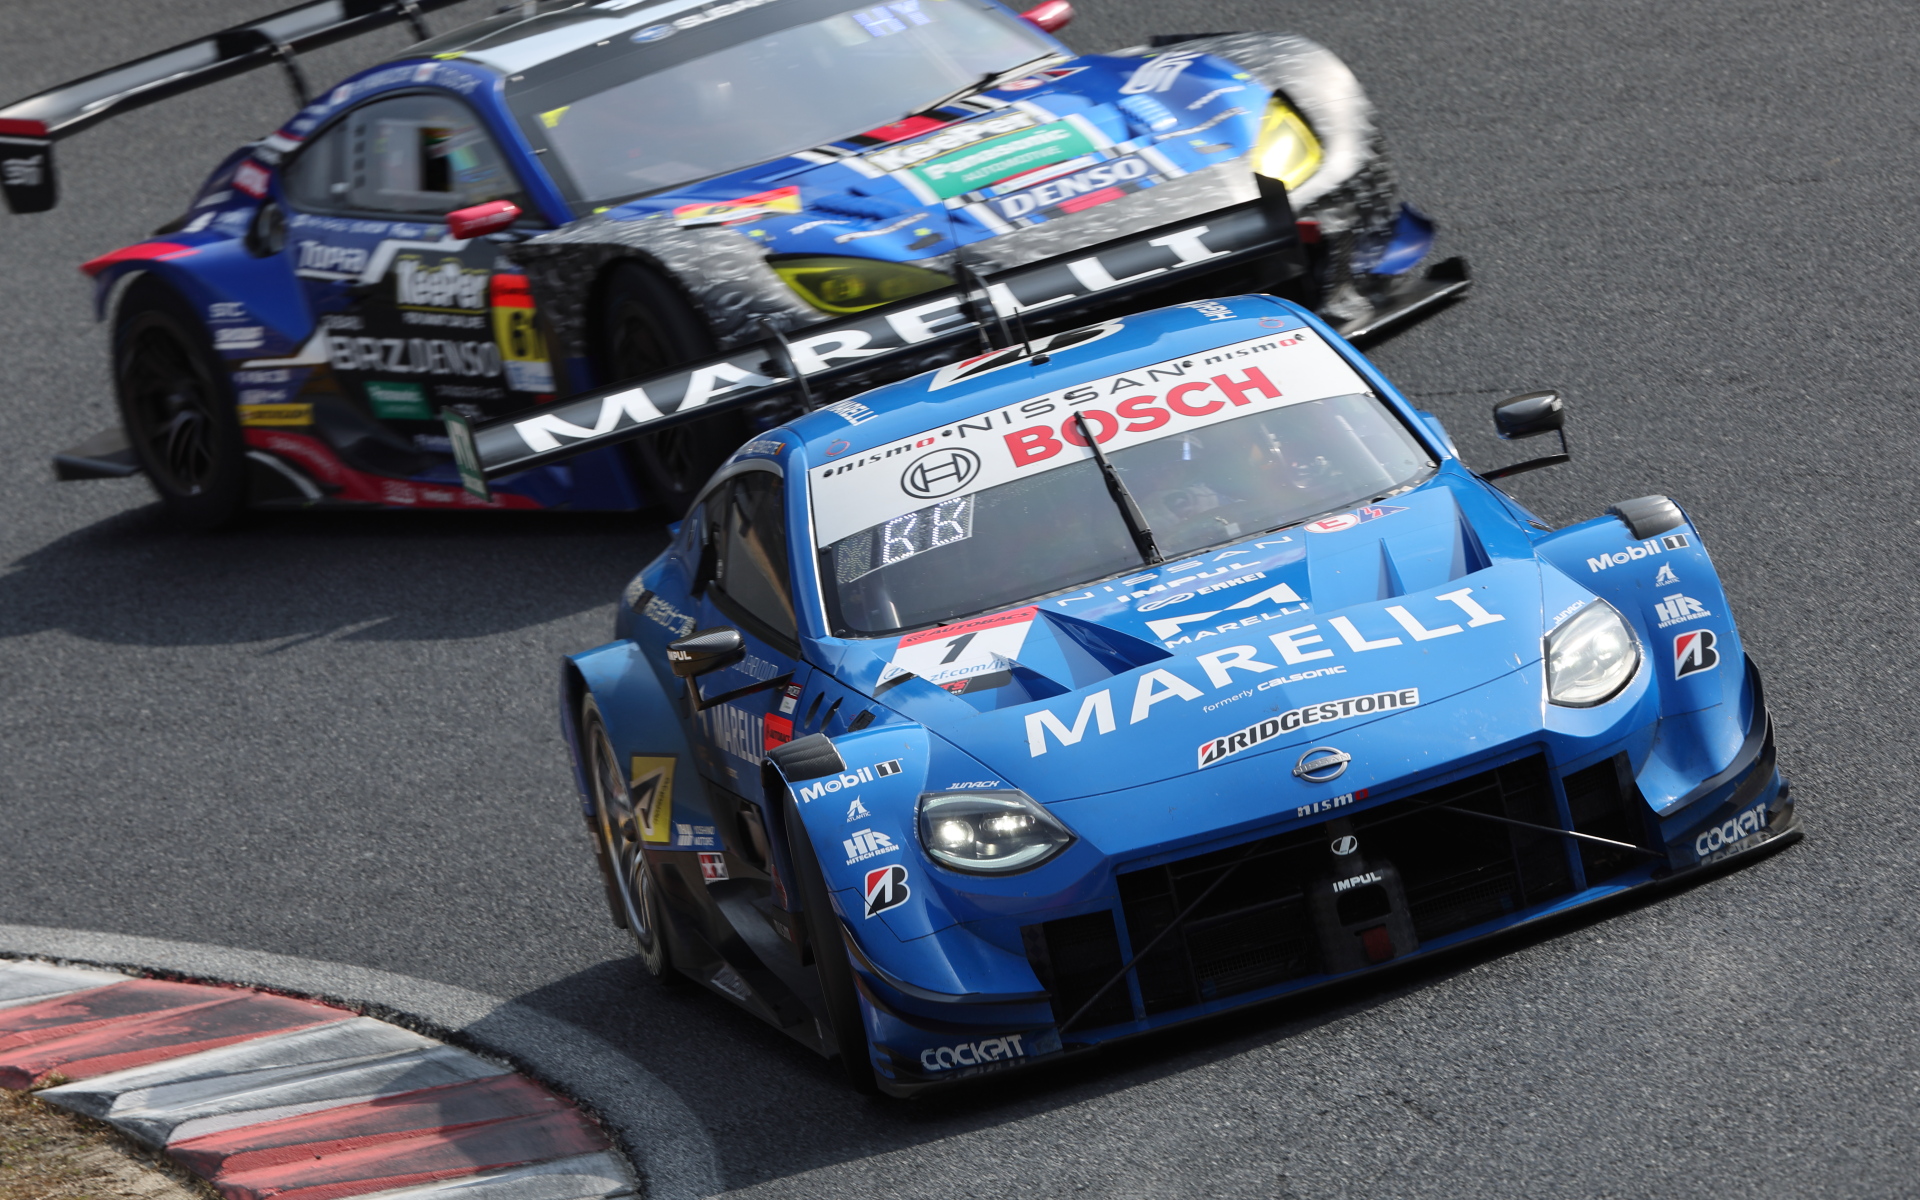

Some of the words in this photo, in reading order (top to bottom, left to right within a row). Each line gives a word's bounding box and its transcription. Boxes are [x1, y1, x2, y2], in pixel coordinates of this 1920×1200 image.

[867, 111, 1036, 168] KeePer
[922, 128, 1072, 180] Panasonic
[962, 145, 1064, 183] AUTOMOTIVE
[1001, 158, 1149, 219] DENSO
[396, 258, 490, 308] KeePer
[514, 226, 1231, 453] MARELLI
[837, 437, 935, 476] nismo
[957, 363, 1187, 439] NISSAN
[1205, 338, 1297, 366] nismo
[1003, 366, 1283, 468] BOSCH
[1057, 535, 1293, 607] NISSAN
[1586, 539, 1662, 573] Mobil
[1116, 560, 1263, 604] IMPUL
[1195, 571, 1267, 597] ENKEI
[1165, 602, 1310, 649] MARELLI
[1657, 615, 1688, 629] HITECH
[1686, 610, 1712, 621] RESIN
[939, 631, 978, 665] 1
[1025, 587, 1506, 758] MARELLI
[1203, 688, 1254, 714] formerly
[1200, 691, 1417, 768] BRIDGESTONE
[1294, 752, 1351, 776] NISSAN
[799, 766, 874, 804] Mobil
[945, 780, 1000, 790] JUNACK
[1297, 788, 1369, 818] nismo
[1695, 802, 1767, 857] COCKPIT
[845, 852, 875, 866] HITECH
[874, 844, 900, 857] RESIN
[1333, 871, 1382, 893] IMPUL
[920, 1034, 1025, 1071] COCKPIT
